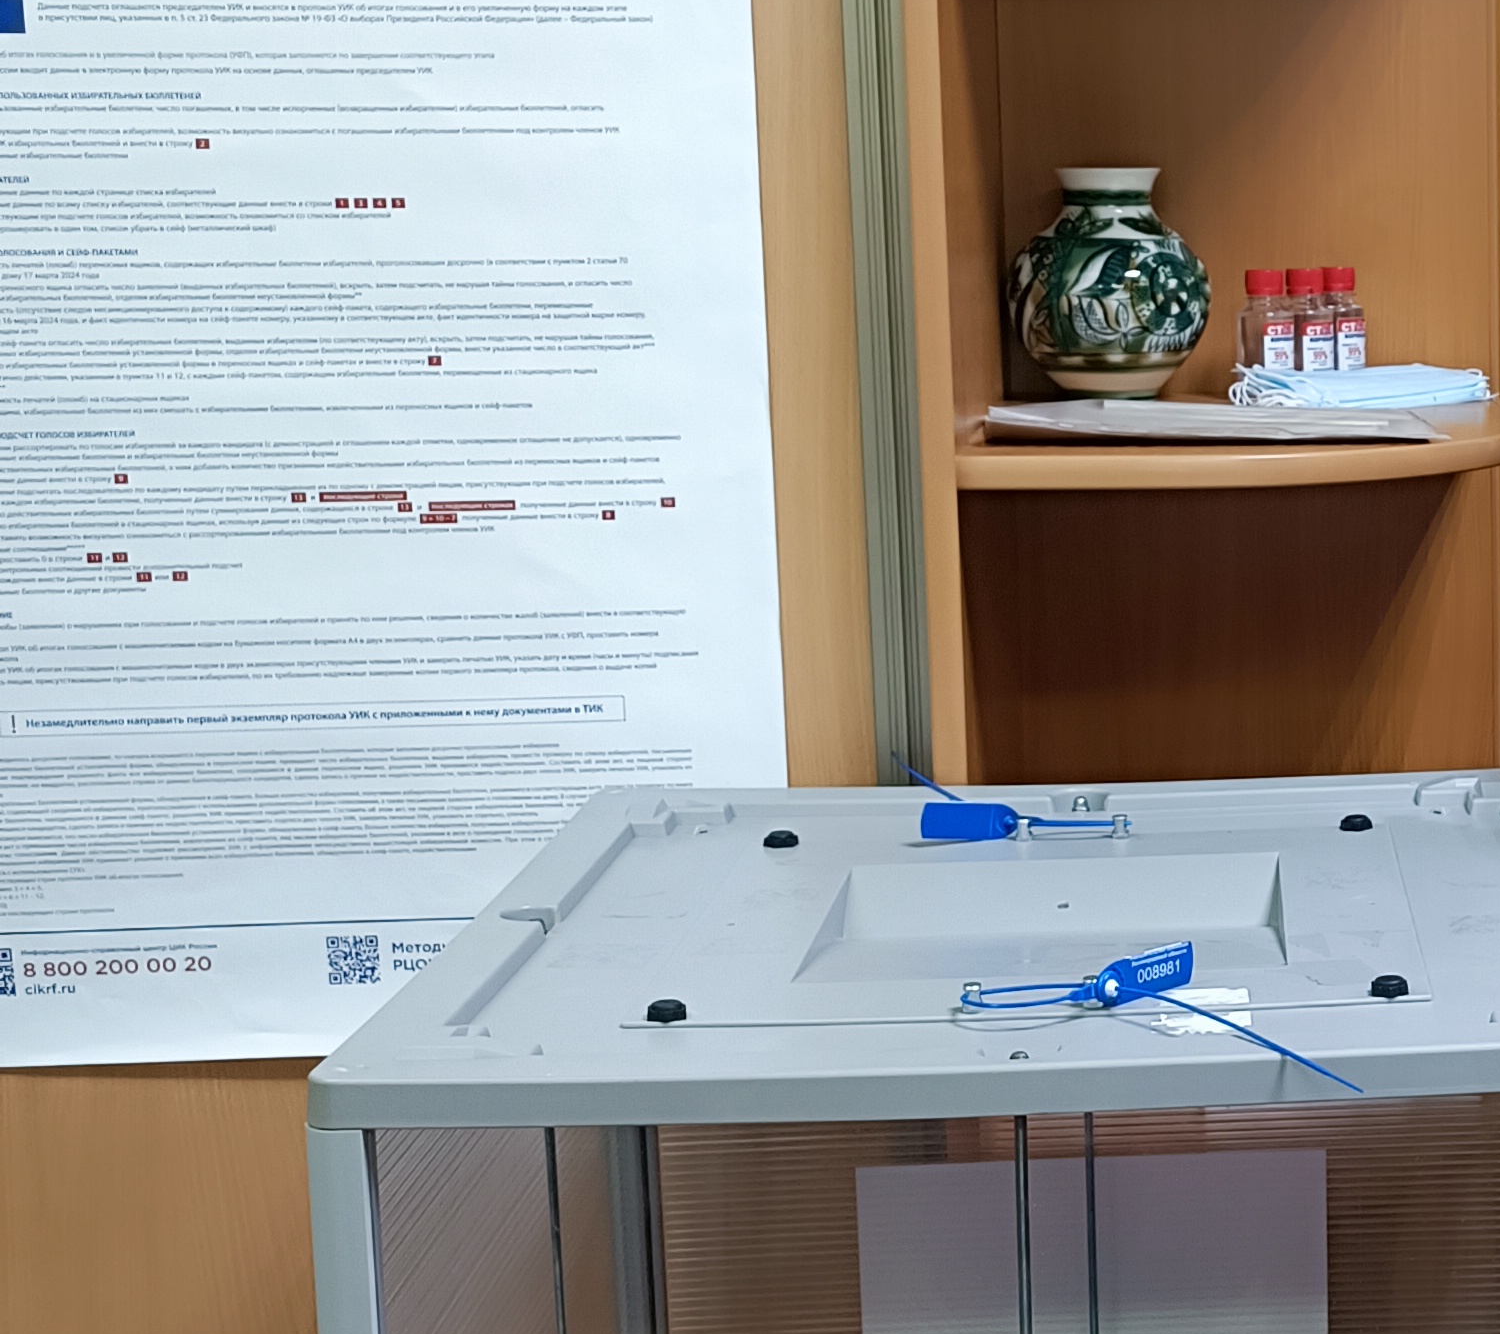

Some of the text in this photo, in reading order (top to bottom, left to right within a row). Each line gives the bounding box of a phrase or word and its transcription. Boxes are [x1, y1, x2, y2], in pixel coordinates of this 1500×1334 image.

[71, 92, 143, 100] ИЗБИРАТЕЛЬНЫХ
[145, 92, 202, 100] БЮЛЛЕТЕНЕЙ
[35, 430, 75, 439] ГОЛОСОВ
[77, 430, 136, 439] ИЗБИРАТЕЛЕЙ
[26, 717, 125, 729] Незамедлительно
[126, 716, 185, 727] направить
[186, 714, 229, 726] первый
[230, 714, 289, 724] экземпляр
[290, 712, 347, 723] протокола
[348, 710, 371, 720] УИК
[379, 709, 464, 720] приложенными
[473, 709, 500, 719] нему
[501, 706, 572, 717] документами
[583, 703, 604, 714] ТИК
[392, 941, 446, 954] Метод
[22, 955, 212, 978] 8 800 200 00 20
[393, 958, 432, 972] РЦО
[1136, 958, 1180, 984] 008981
